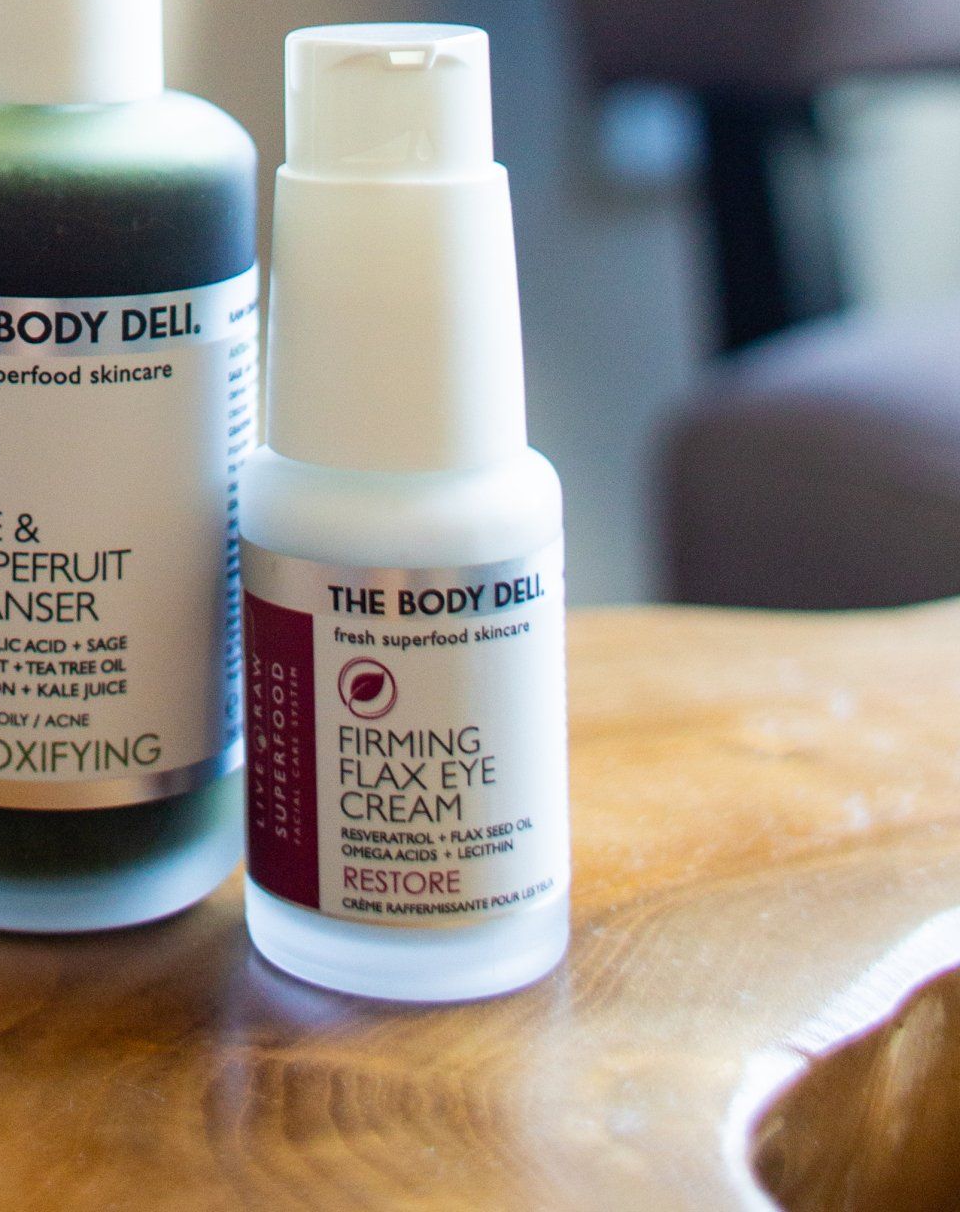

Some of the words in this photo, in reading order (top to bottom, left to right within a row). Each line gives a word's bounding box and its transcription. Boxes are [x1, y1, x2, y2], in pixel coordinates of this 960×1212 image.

[90, 361, 172, 384] skincare
[14, 513, 40, 543] &
[328, 585, 385, 615] THE
[399, 585, 485, 615] BODY
[24, 638, 66, 654] ACID
[73, 642, 81, 651] +
[87, 635, 128, 652] SAGE
[334, 627, 375, 645] fresh
[383, 628, 468, 650] superfood
[475, 621, 529, 641] skincare
[14, 662, 23, 672] +
[26, 660, 56, 675] TEA
[59, 660, 96, 675] TREE
[101, 658, 126, 673] OIL
[22, 685, 30, 695] +
[38, 682, 78, 697] KALE
[83, 679, 127, 700] JUICE
[45, 714, 89, 727] ACNE
[272, 662, 288, 839] SUPERFOOD
[339, 725, 480, 758] FIRMING
[340, 758, 427, 790] FLAX
[442, 756, 495, 789] EYE
[340, 791, 462, 823] CREAM
[342, 827, 434, 844] RESVERATROL
[440, 834, 446, 842] +
[451, 827, 483, 843] FLAX
[487, 822, 513, 838] SEED
[517, 817, 533, 832] OIL
[341, 844, 392, 860] OMEGA
[396, 848, 437, 861] ACIDS
[444, 850, 452, 858] +
[458, 839, 513, 859] LECITHIN
[343, 865, 460, 894] RESTORE
[386, 899, 489, 914] RAFFERMISSANTE
[491, 892, 519, 907] POUR
